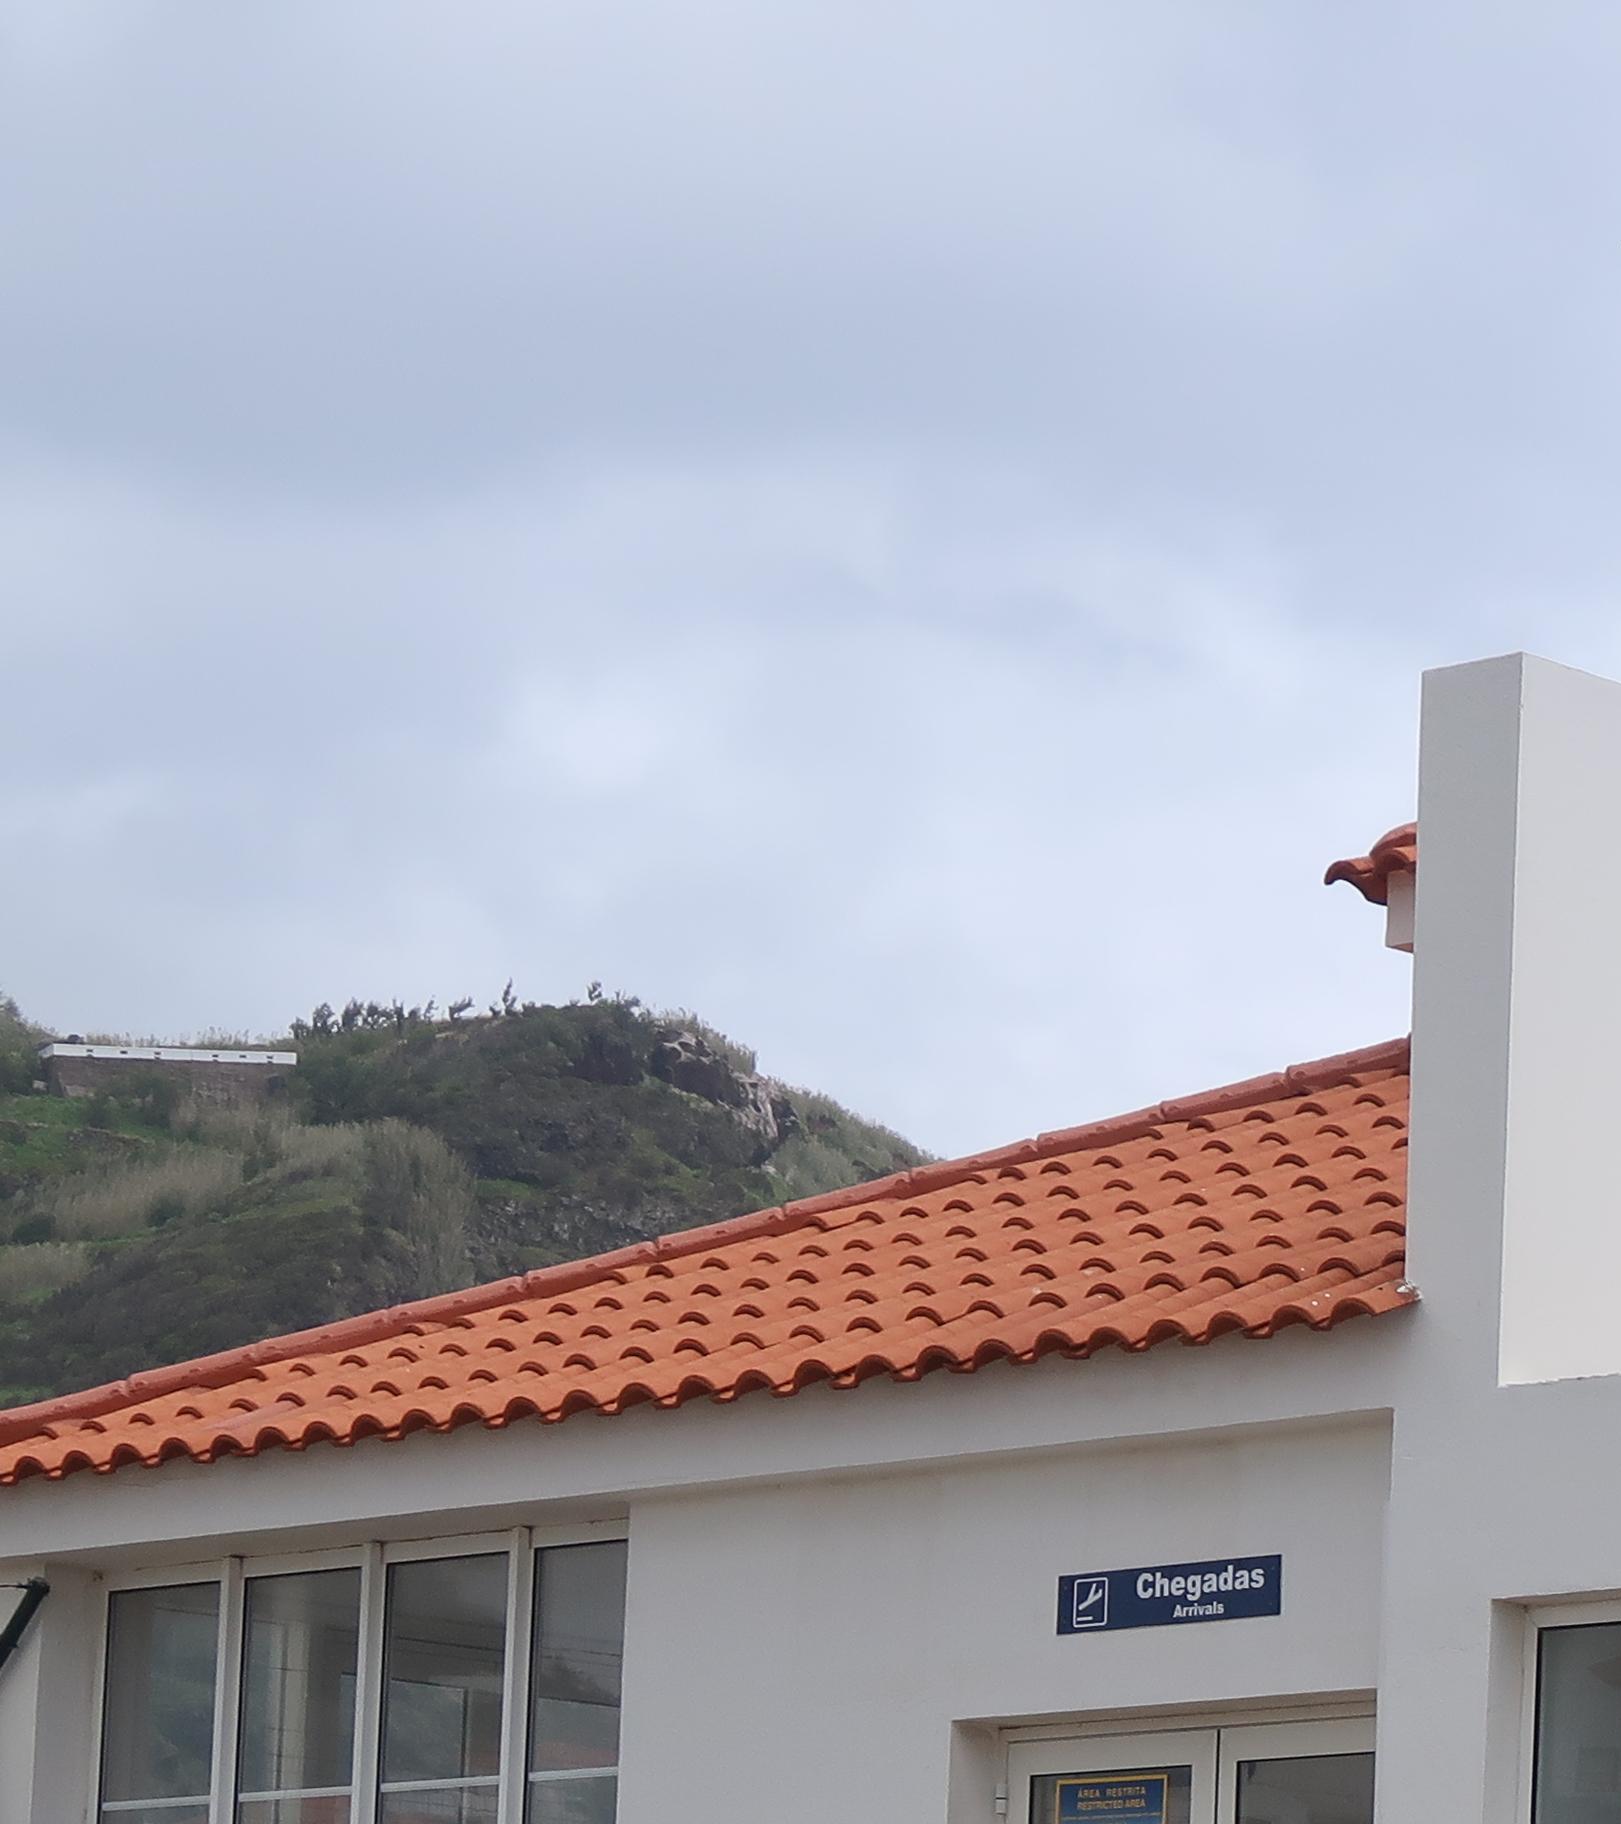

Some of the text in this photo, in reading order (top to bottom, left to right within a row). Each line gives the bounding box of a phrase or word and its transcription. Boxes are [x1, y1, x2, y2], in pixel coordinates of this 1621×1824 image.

[1136, 1565, 1265, 1600] Chegadas
[1173, 1601, 1224, 1618] Arrivals
[1106, 1786, 1146, 1797] RESTRITA
[1077, 1799, 1146, 1811] RESTRICTED AREA
